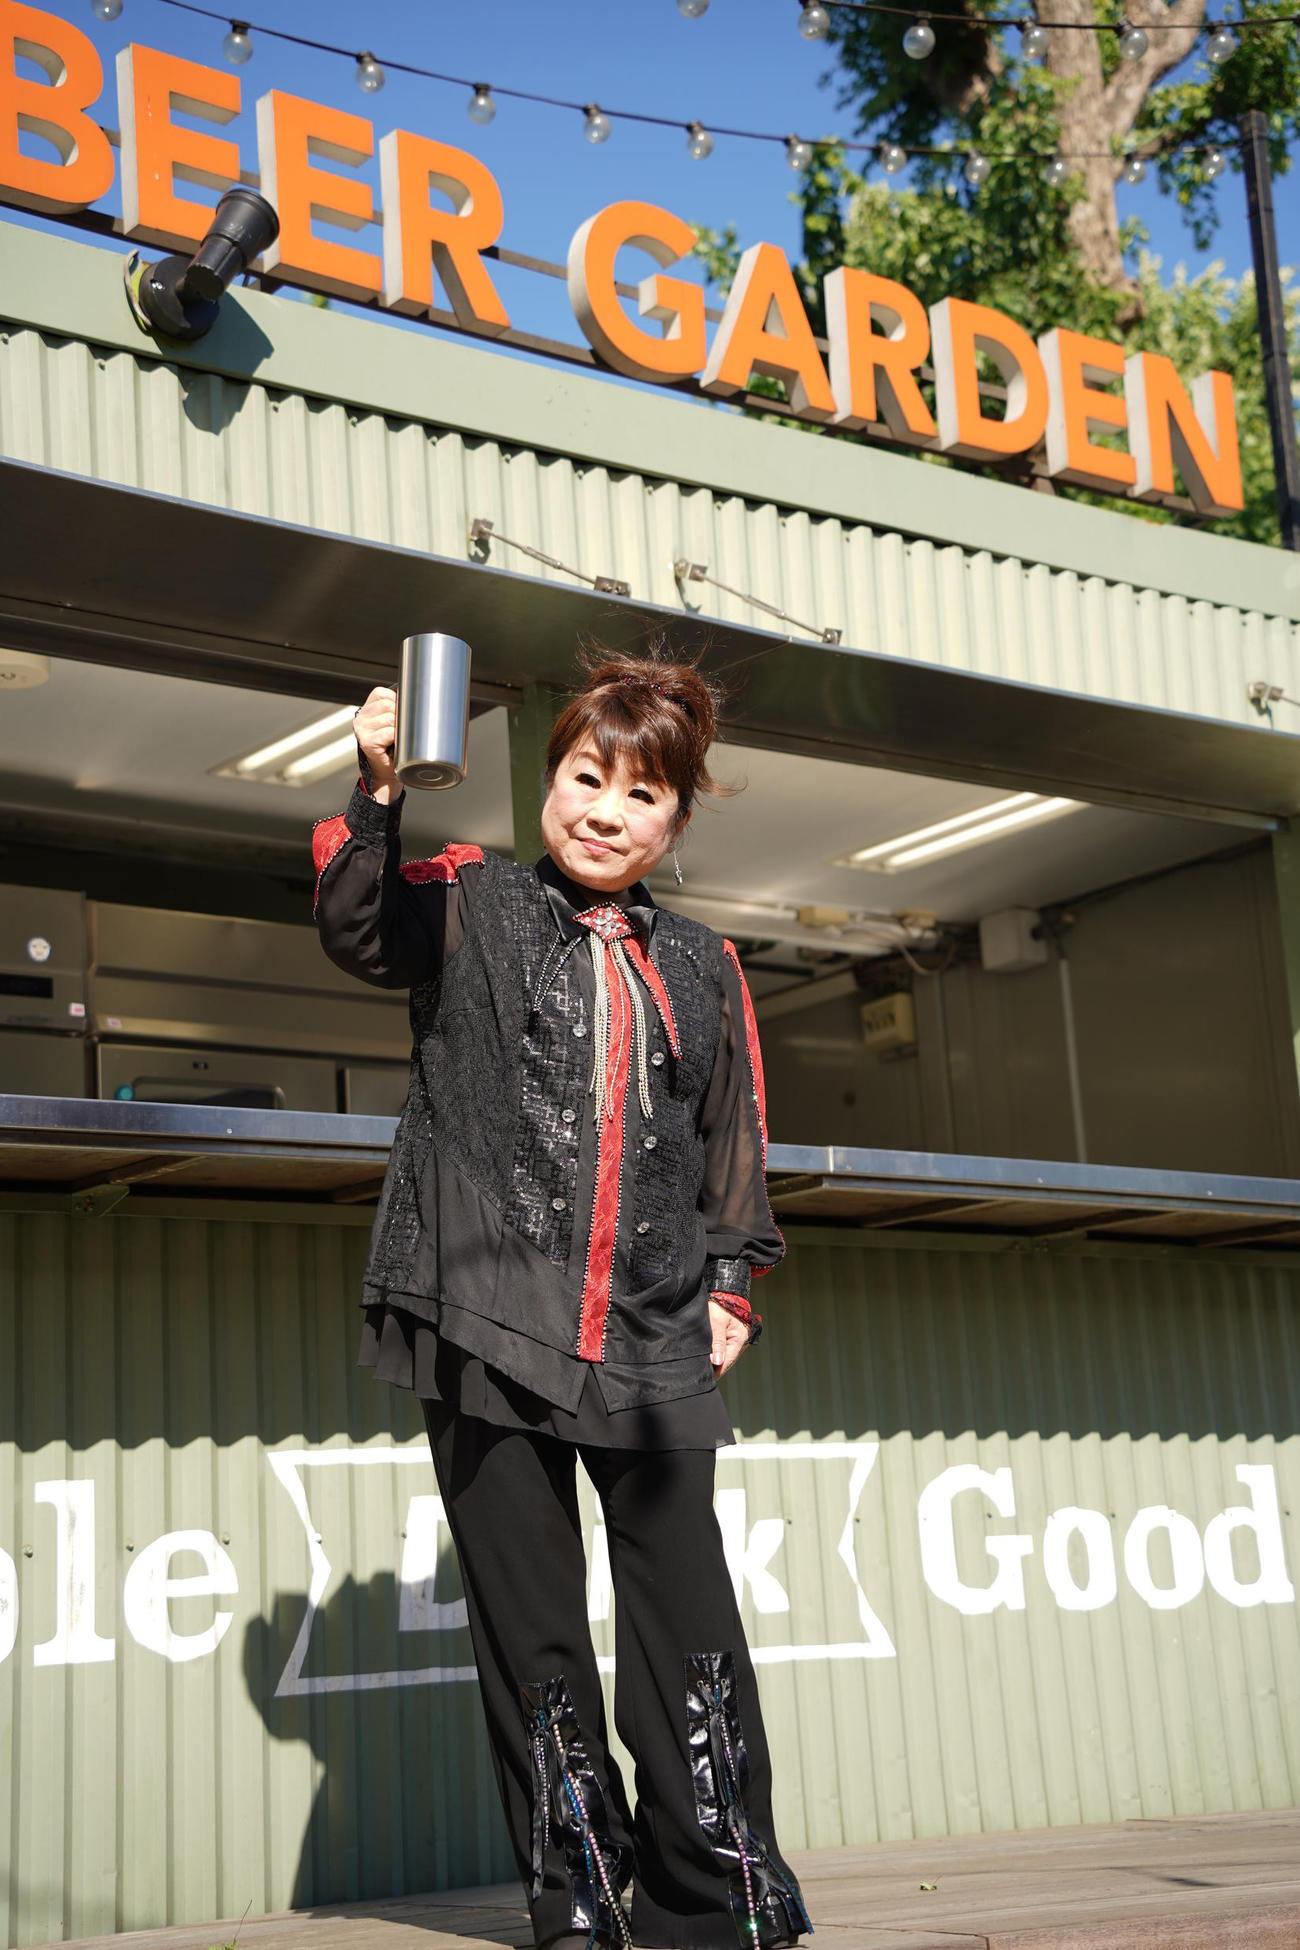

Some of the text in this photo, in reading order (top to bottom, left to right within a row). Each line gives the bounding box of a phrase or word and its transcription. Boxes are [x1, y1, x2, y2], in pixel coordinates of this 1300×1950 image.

[0, 0, 1244, 515] BEER GARDEN
[0, 1479, 239, 1667] le
[918, 1464, 1295, 1615] Good
